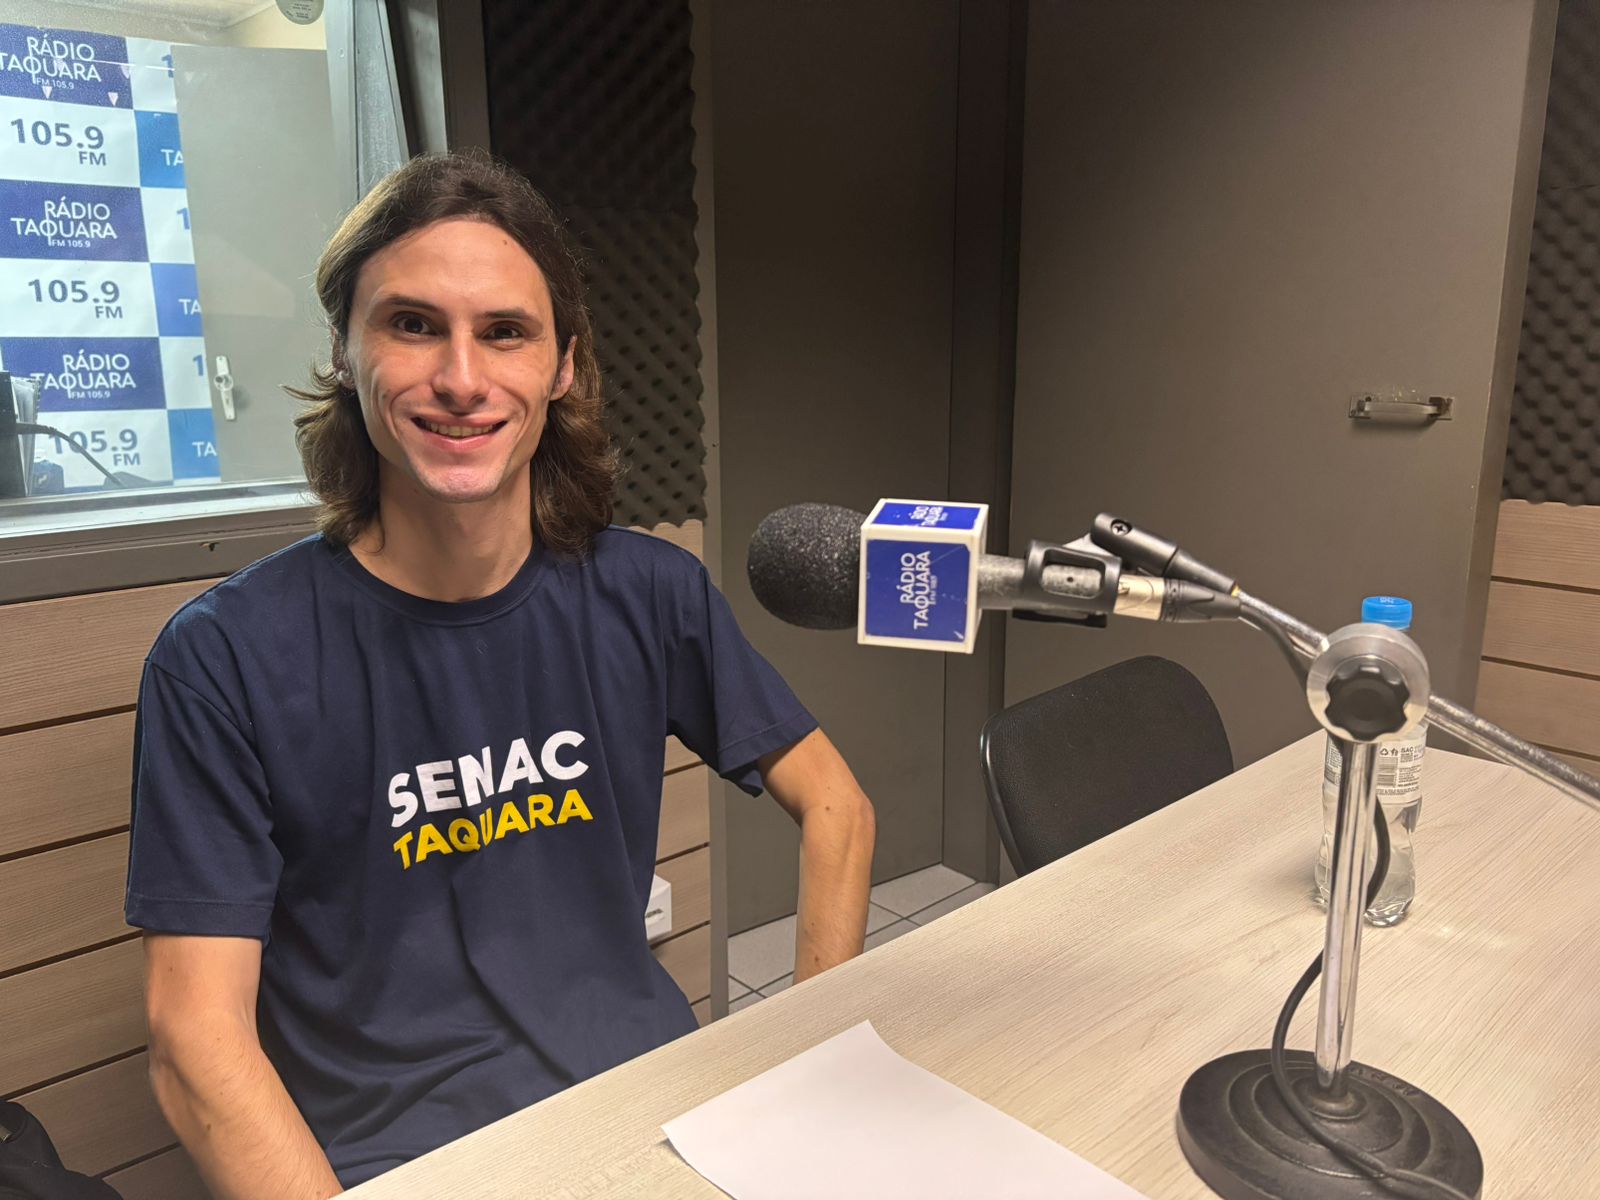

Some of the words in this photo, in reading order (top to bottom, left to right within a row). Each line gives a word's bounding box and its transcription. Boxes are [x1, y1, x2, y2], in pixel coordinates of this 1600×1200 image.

[27, 34, 94, 62] RÁDIO
[36, 78, 50, 87] FM
[52, 79, 75, 90] 105.9
[11, 118, 104, 149] 105.9
[79, 151, 107, 166] FM
[44, 196, 111, 221] RÁDIO
[10, 217, 117, 244] TAQUARA
[51, 239, 66, 248] FM
[67, 239, 91, 248] 105.9
[28, 279, 120, 304] 105.9
[95, 305, 123, 319] FM
[63, 349, 130, 371] RÁDIO
[71, 390, 86, 399] FM
[87, 390, 111, 399] 105.9
[113, 453, 141, 466] FM
[896, 552, 916, 603] RÁDIO
[913, 550, 931, 630] TAQUARA
[388, 730, 589, 828] SENAC
[393, 788, 594, 870] TAQUARA
